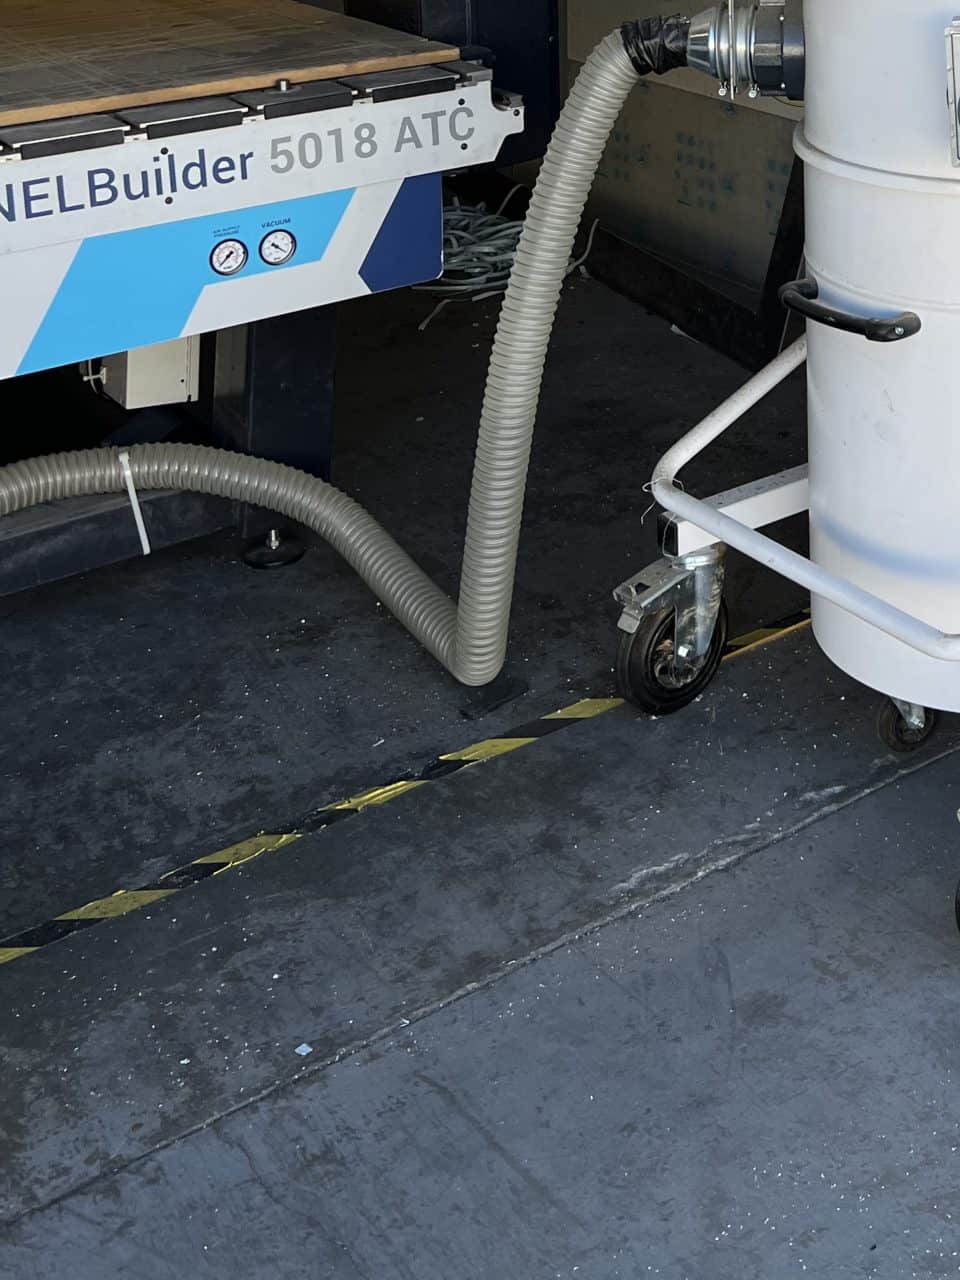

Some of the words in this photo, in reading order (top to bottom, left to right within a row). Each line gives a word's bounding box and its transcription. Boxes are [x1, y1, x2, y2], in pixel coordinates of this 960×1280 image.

[270, 122, 378, 174] 5018
[394, 106, 476, 153] ATC
[261, 217, 291, 229] VACUUM
